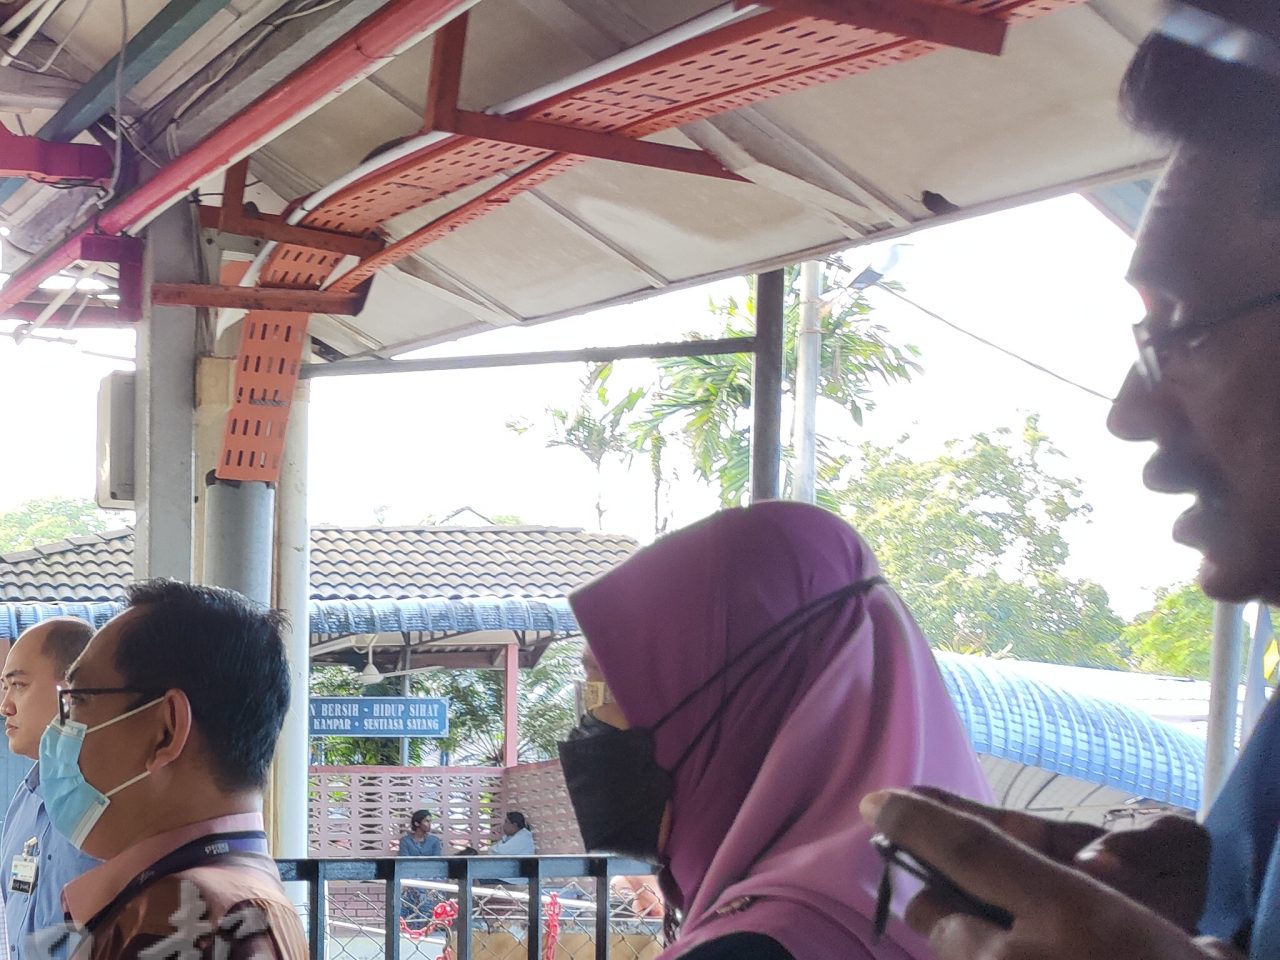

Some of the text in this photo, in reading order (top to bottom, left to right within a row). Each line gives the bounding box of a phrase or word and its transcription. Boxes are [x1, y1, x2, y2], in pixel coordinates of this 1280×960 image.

[321, 703, 360, 717] BERSIH
[373, 703, 405, 717] HIDUP
[409, 703, 440, 717] SIHAT
[313, 718, 440, 731] KAMPAR SENTIASA SAYANG
